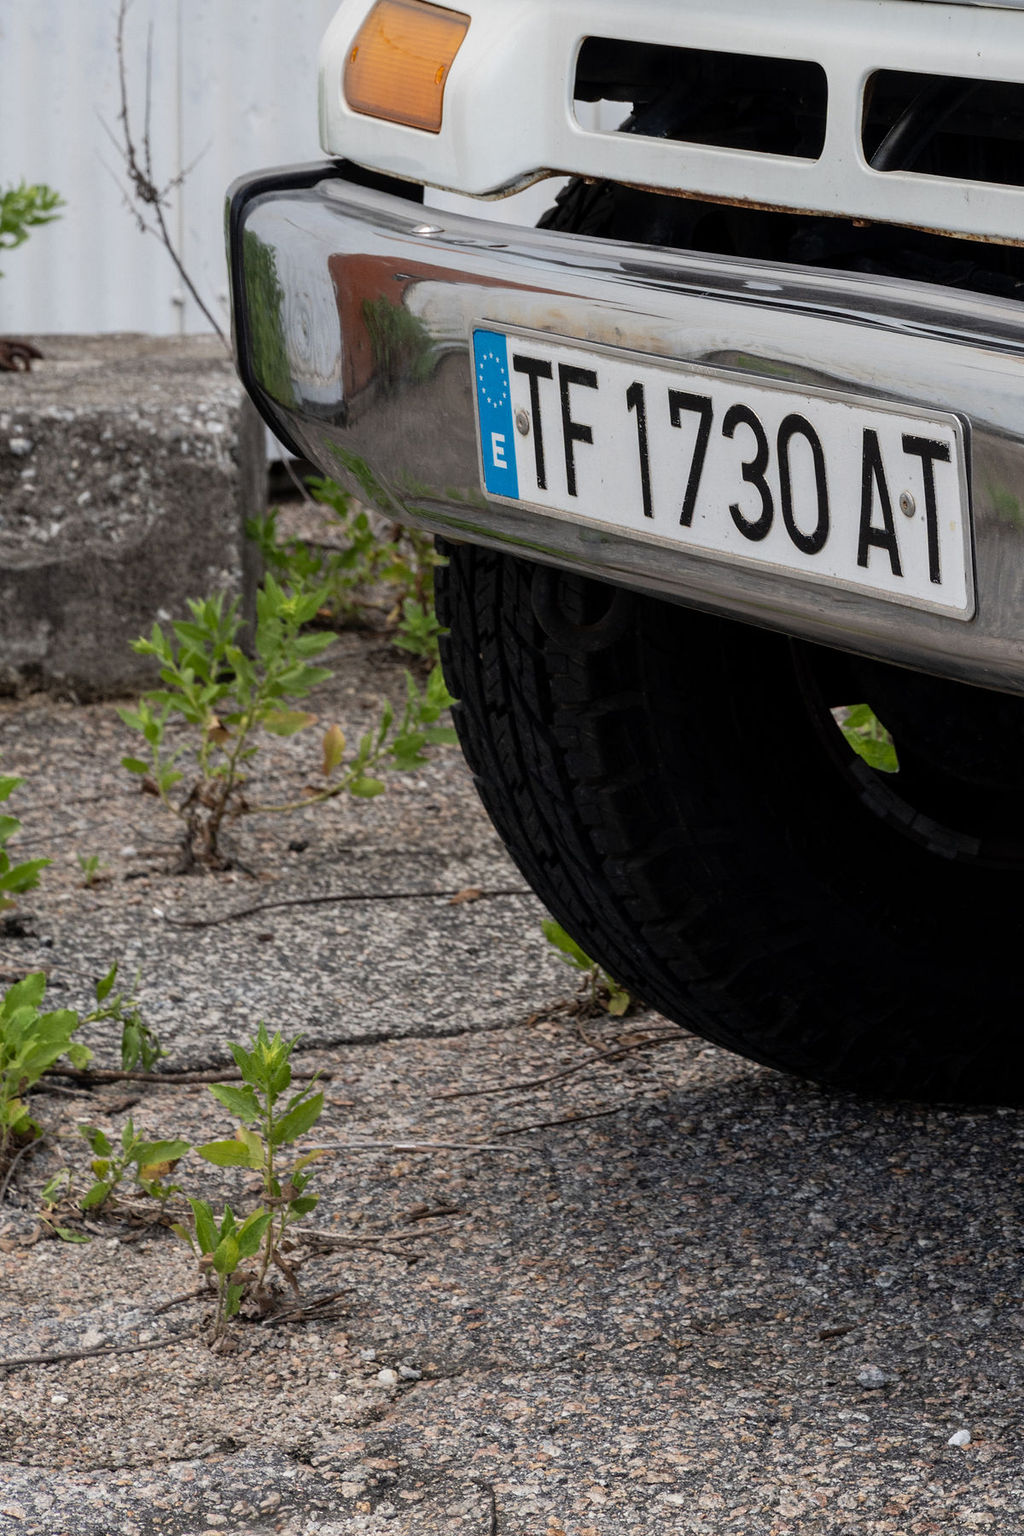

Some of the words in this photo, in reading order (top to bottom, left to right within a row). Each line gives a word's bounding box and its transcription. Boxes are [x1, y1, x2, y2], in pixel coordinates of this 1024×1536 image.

[491, 432, 508, 469] E
[513, 353, 599, 497] TF
[626, 381, 830, 555] 1730
[856, 427, 952, 585] AT
